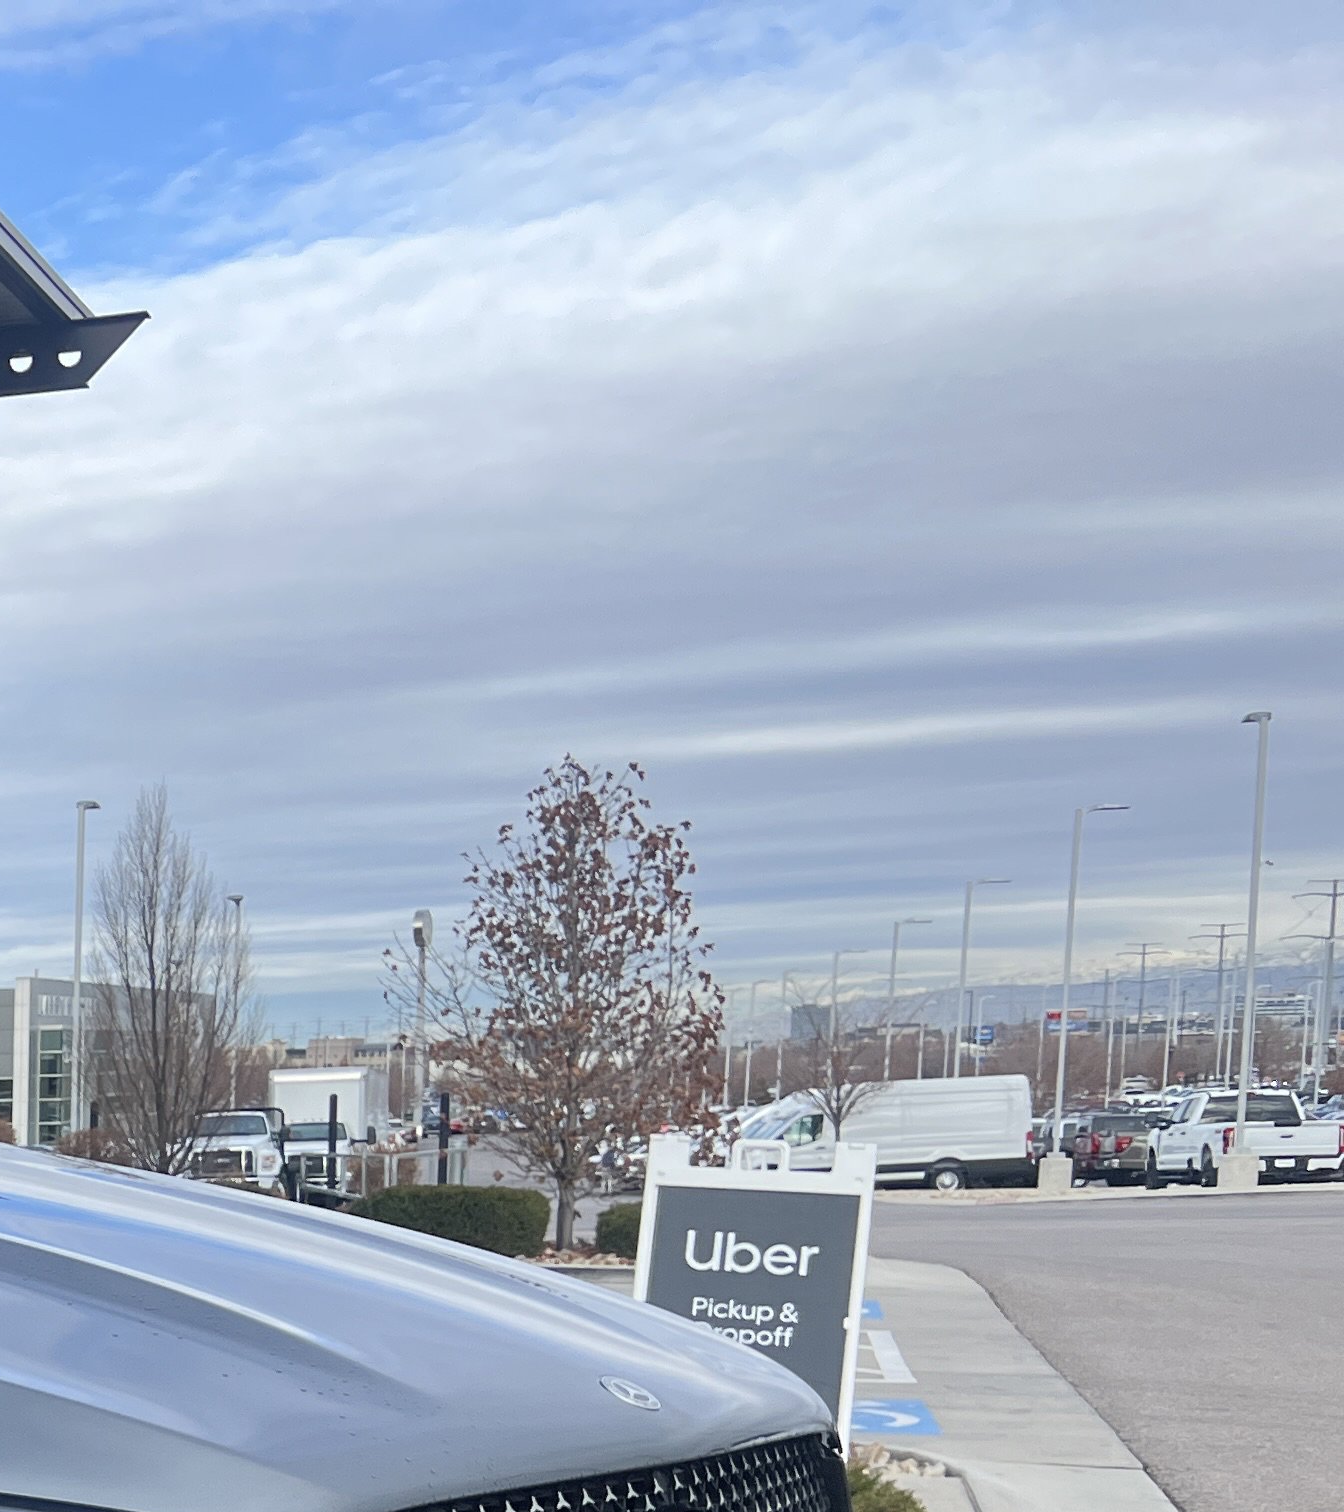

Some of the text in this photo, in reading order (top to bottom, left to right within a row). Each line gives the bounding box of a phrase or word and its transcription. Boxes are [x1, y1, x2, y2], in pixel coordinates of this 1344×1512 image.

[685, 1229, 820, 1276] Uber
[691, 1297, 799, 1325] Pickup &
[693, 1321, 794, 1348] ropoff
